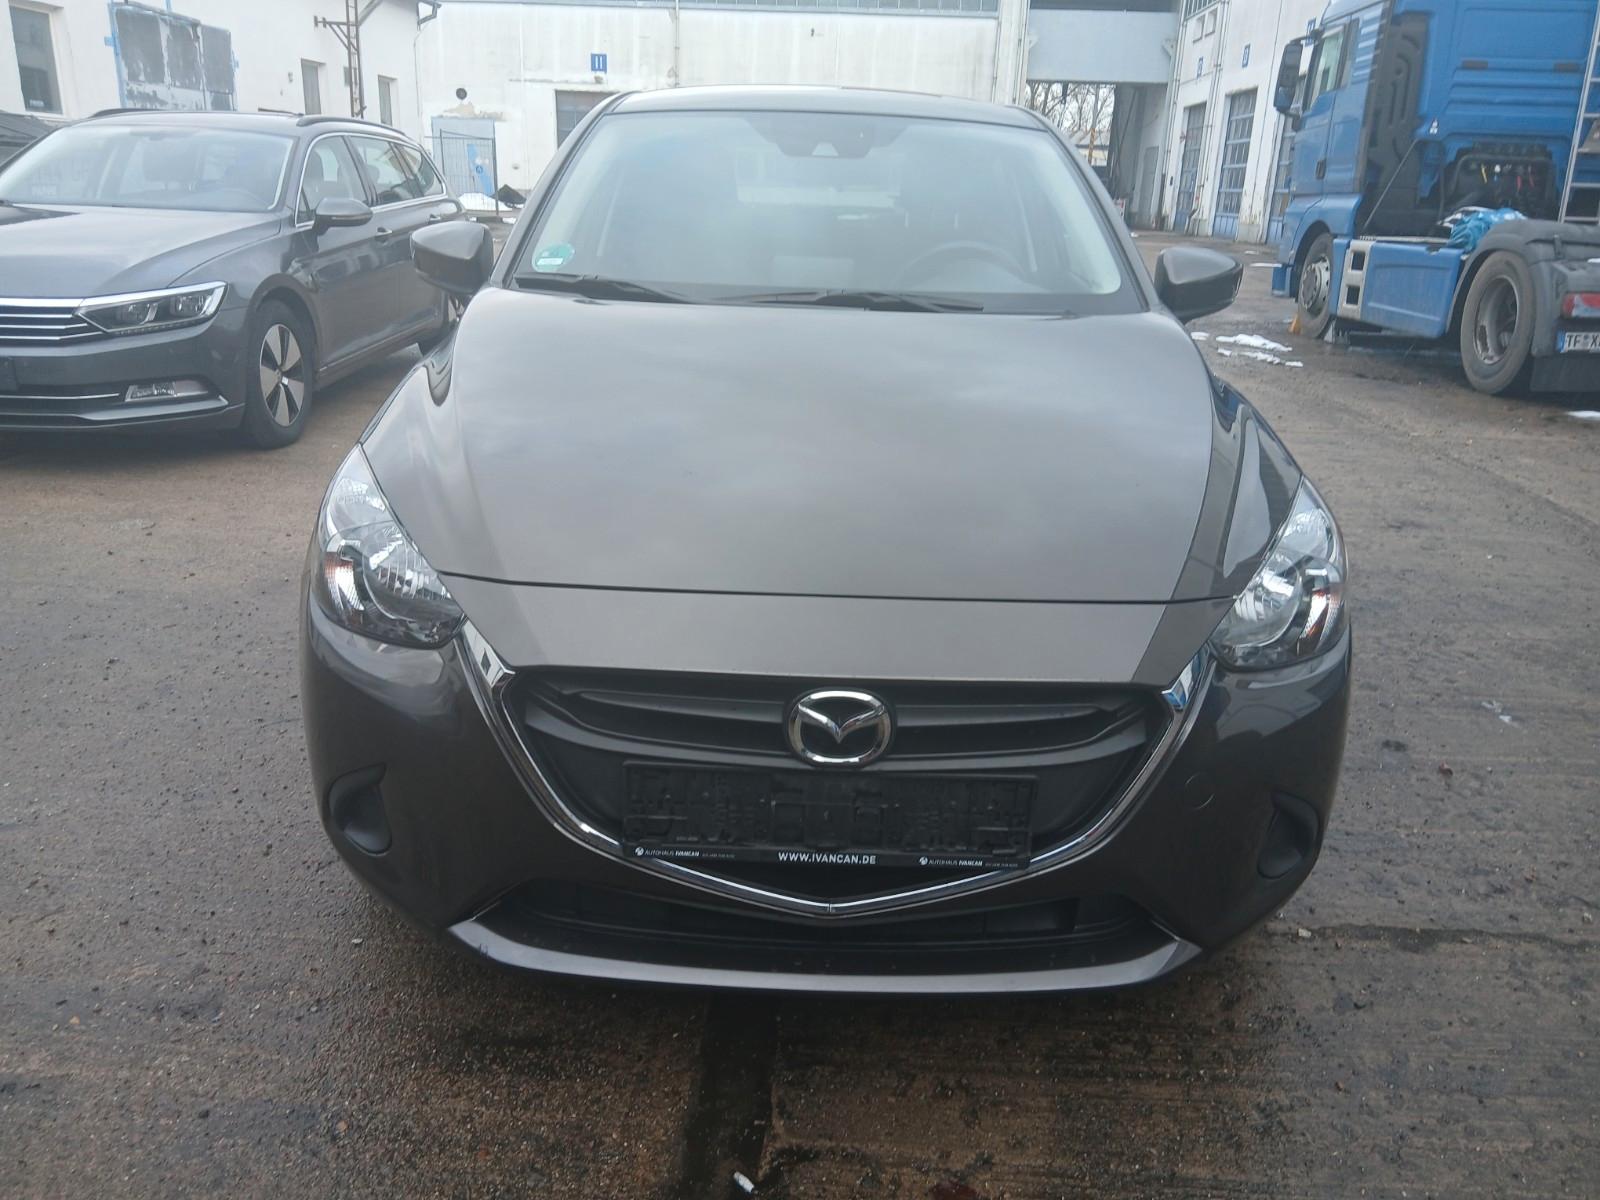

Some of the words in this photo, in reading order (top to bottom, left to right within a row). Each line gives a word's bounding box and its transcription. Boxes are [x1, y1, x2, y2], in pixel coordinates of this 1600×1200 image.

[1566, 334, 1582, 348] TF
[1590, 334, 1600, 348] X
[778, 851, 876, 865] WWW.IVANCAN.DE
